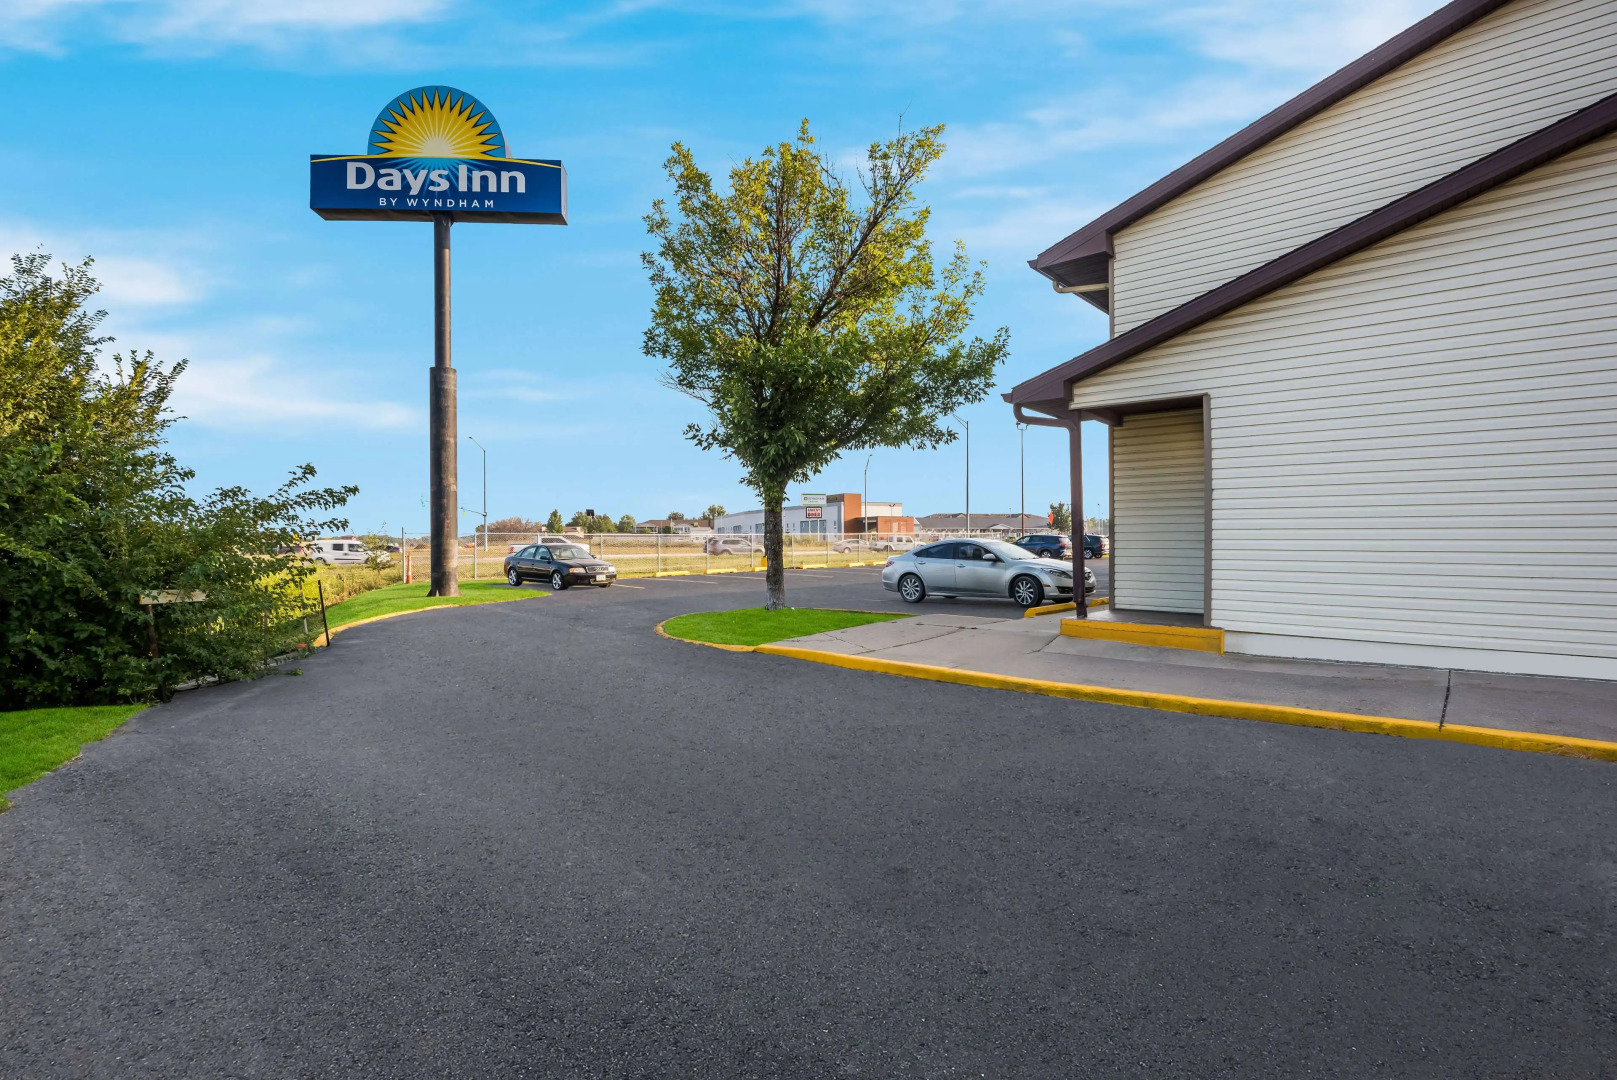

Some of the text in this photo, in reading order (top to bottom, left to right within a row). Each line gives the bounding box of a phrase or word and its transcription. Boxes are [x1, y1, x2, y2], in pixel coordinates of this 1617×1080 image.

[346, 161, 526, 195] Days Inn
[379, 197, 494, 208] BY WYNDHAM
